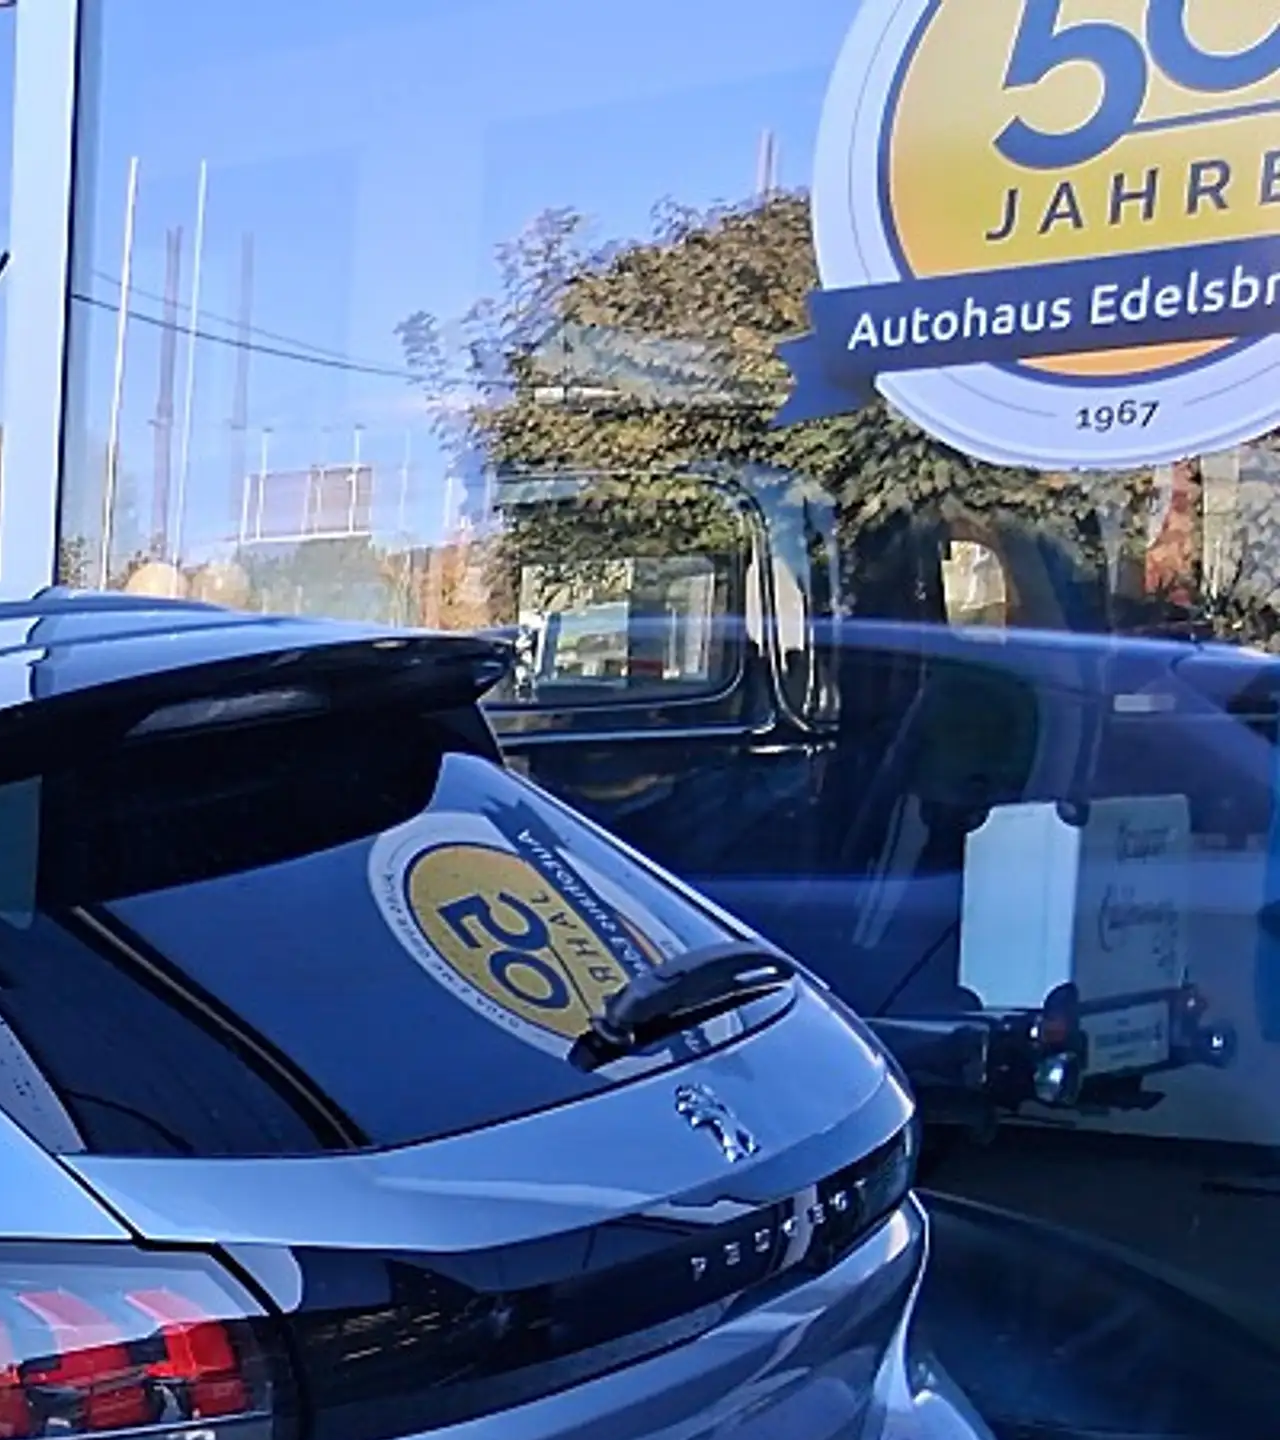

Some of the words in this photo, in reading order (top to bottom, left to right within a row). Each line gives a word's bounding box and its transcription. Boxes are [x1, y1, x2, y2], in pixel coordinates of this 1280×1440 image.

[847, 297, 1072, 351] Autohaus
[1090, 264, 1280, 325] Edelsbr
[1075, 401, 1161, 432] 1967
